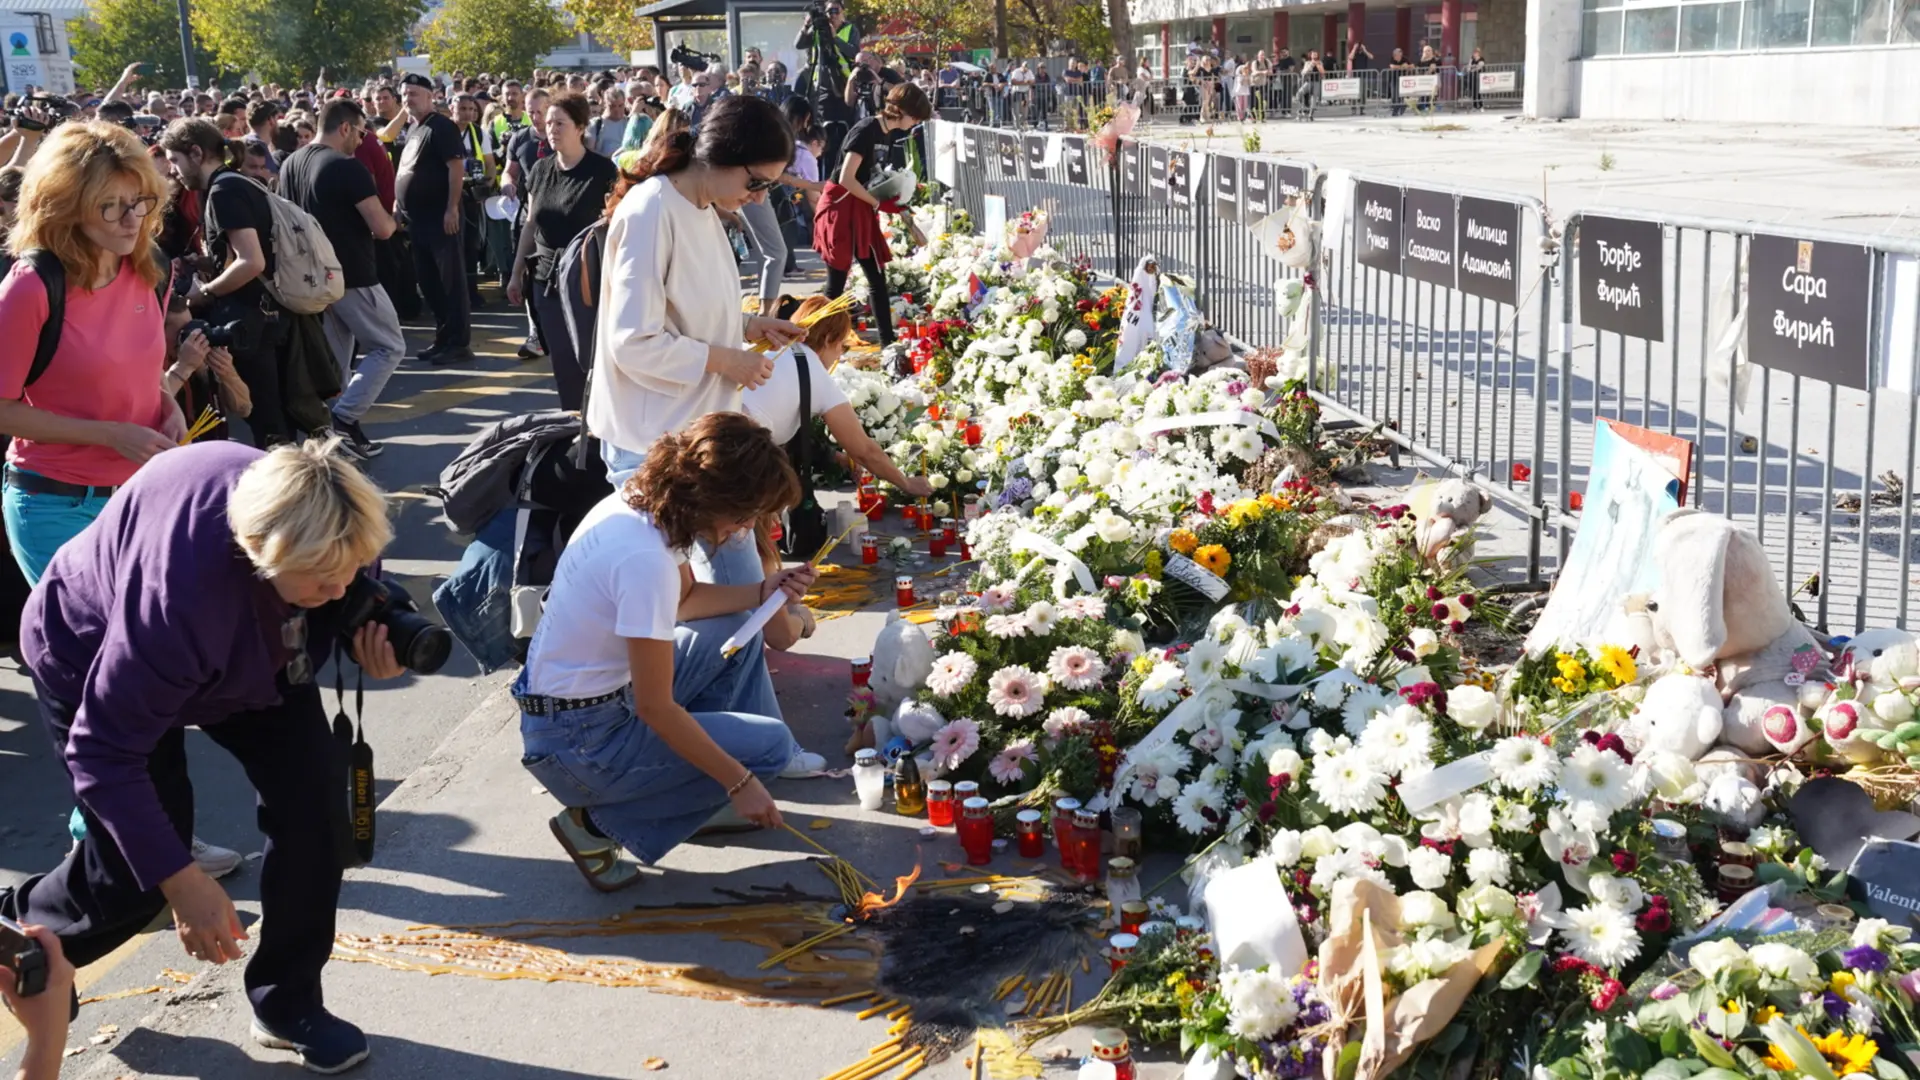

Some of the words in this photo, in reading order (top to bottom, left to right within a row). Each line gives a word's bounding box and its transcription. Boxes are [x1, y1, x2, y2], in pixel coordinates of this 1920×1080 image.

[1364, 199, 1393, 222] Анђела
[1416, 208, 1441, 232] Васко
[1366, 227, 1389, 251] Руман
[1466, 218, 1508, 247] Милица
[1462, 250, 1512, 280] Адамовић
[1596, 239, 1641, 273] Ђорђе
[1597, 278, 1641, 312] Фирић
[1782, 265, 1827, 304] Сара
[1773, 308, 1834, 349] Фирић
[355, 768, 369, 804] Nikon
